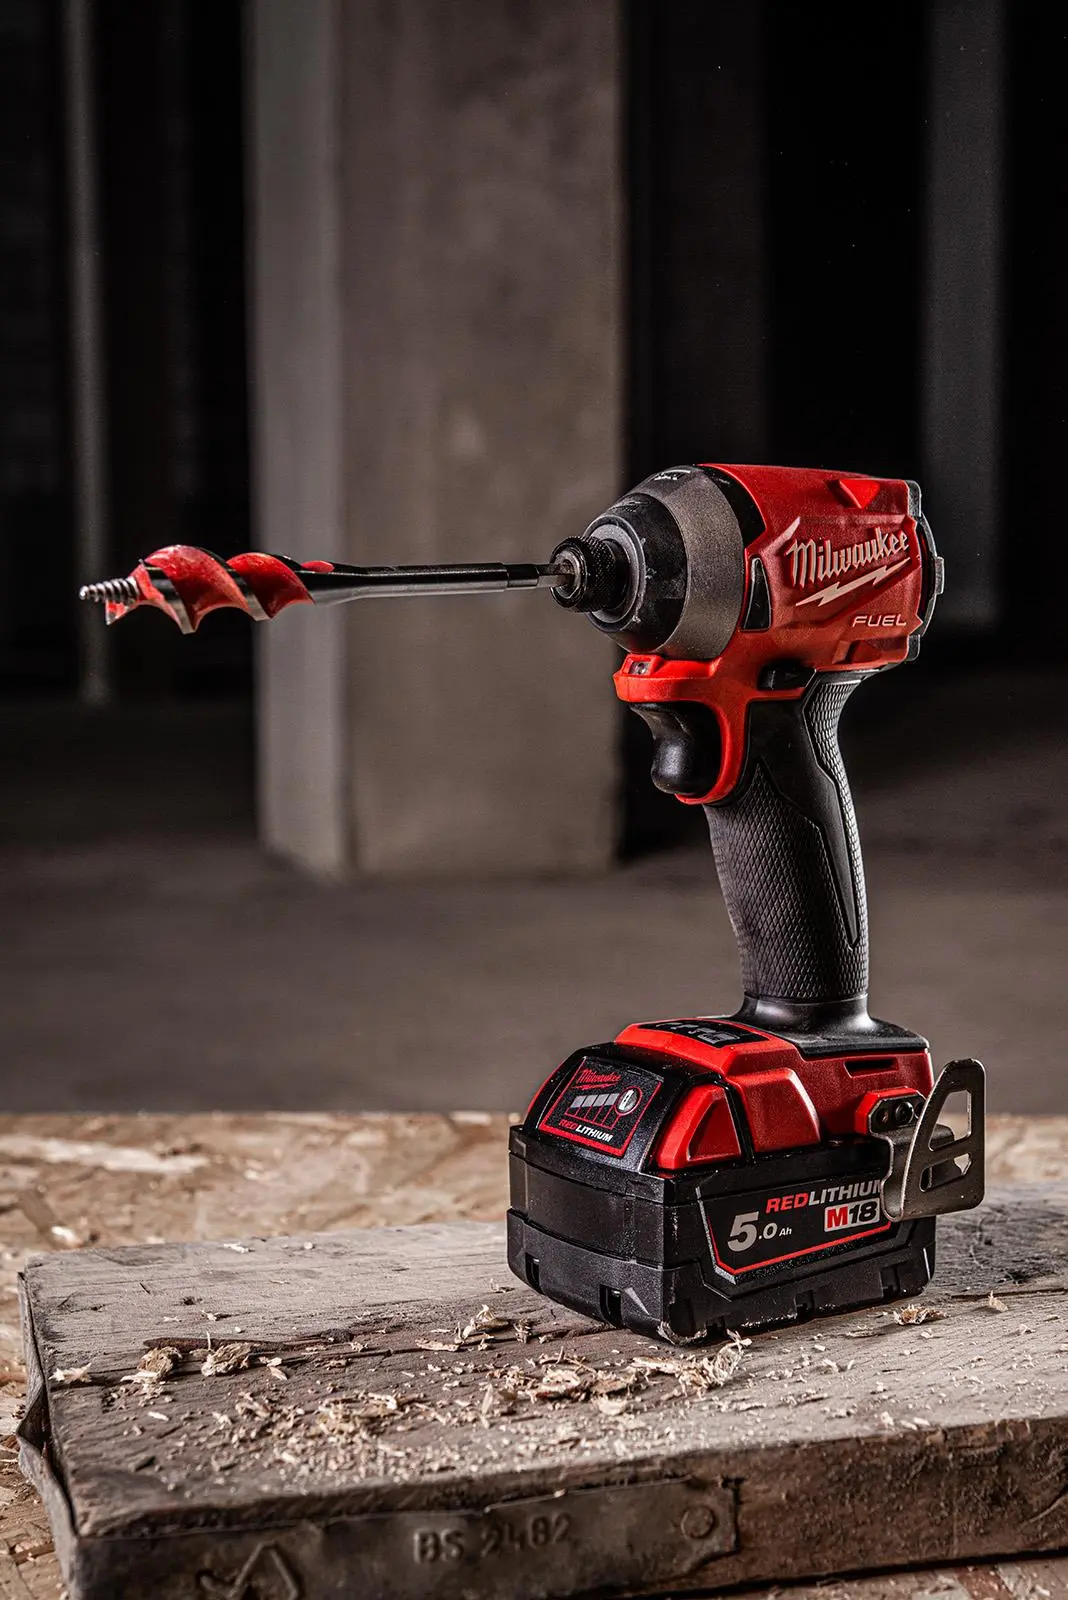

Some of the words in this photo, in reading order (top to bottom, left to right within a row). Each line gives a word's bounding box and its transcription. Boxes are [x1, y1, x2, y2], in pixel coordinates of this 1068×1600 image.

[785, 526, 910, 588] Milwaukee
[852, 613, 907, 628] FUEL
[558, 1118, 614, 1143] REDLITHIUM
[826, 1200, 878, 1229] M18
[778, 1227, 792, 1237] Ah
[413, 1527, 464, 1564] BS
